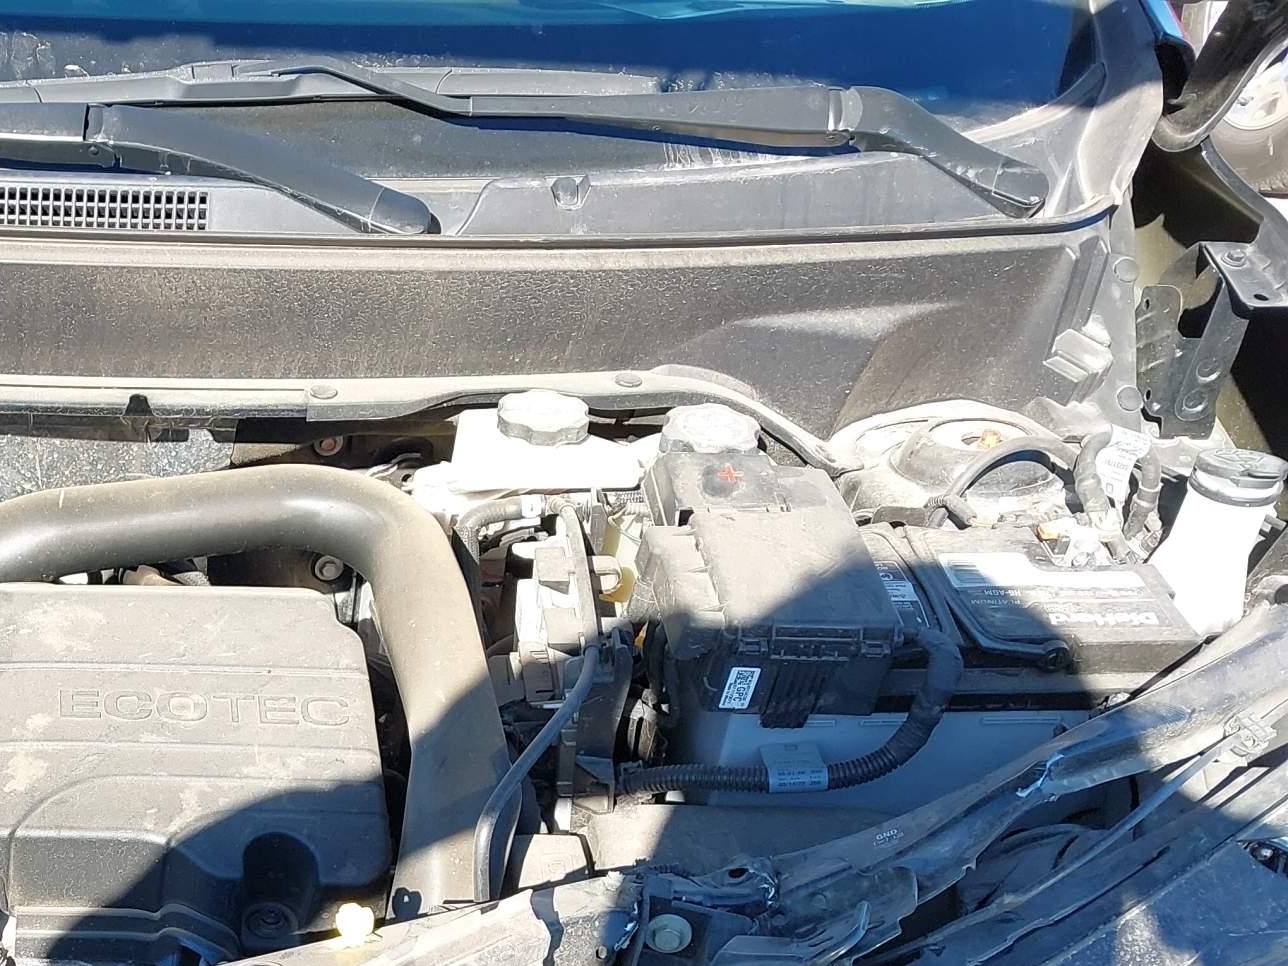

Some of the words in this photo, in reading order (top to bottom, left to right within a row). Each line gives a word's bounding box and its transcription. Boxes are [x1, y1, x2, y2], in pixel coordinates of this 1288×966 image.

[970, 598, 1021, 606] PLATINUM
[732, 686, 746, 702] GPC
[59, 689, 350, 726] ECOTEC
